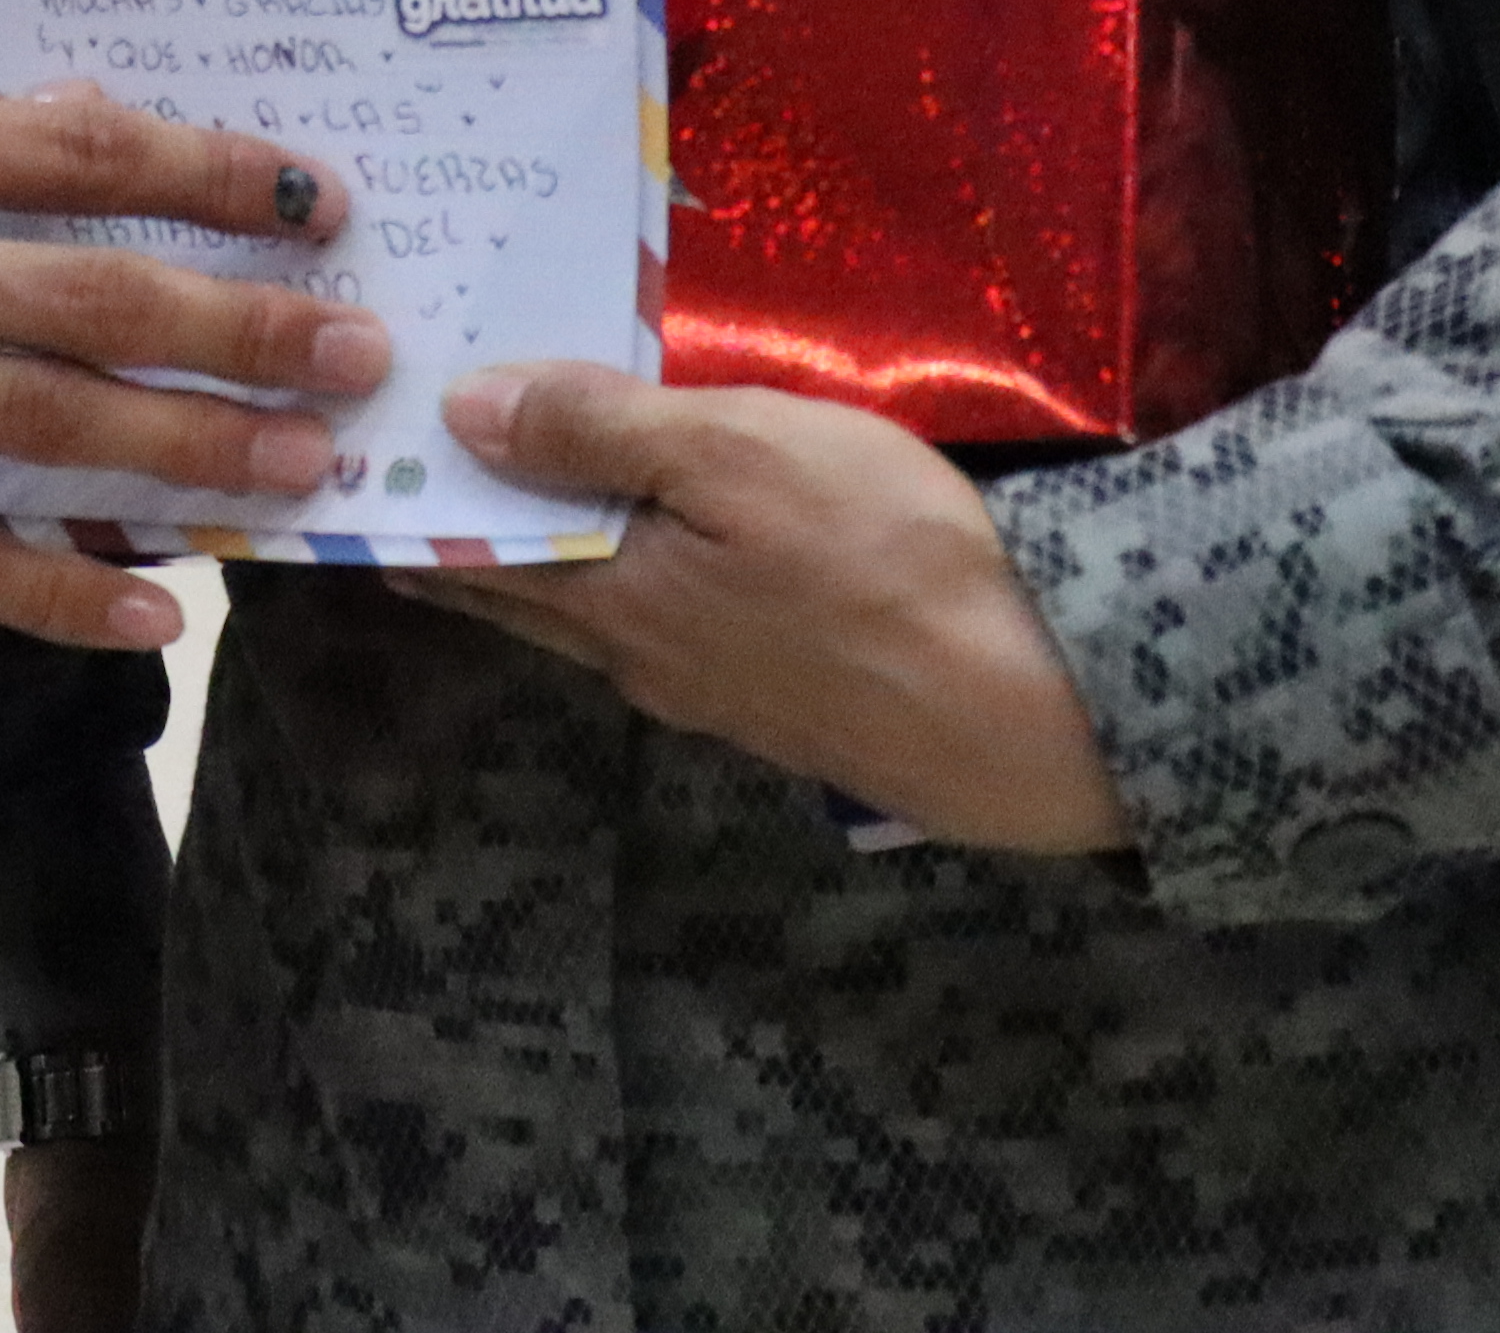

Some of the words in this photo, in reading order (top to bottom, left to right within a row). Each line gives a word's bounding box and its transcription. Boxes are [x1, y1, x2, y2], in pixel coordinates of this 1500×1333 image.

[105, 37, 183, 74] QUE
[225, 37, 357, 75] HONOR
[253, 97, 283, 133] A
[322, 98, 423, 135] LAS
[352, 151, 560, 198] FUERZAS
[377, 210, 463, 259] DEL
